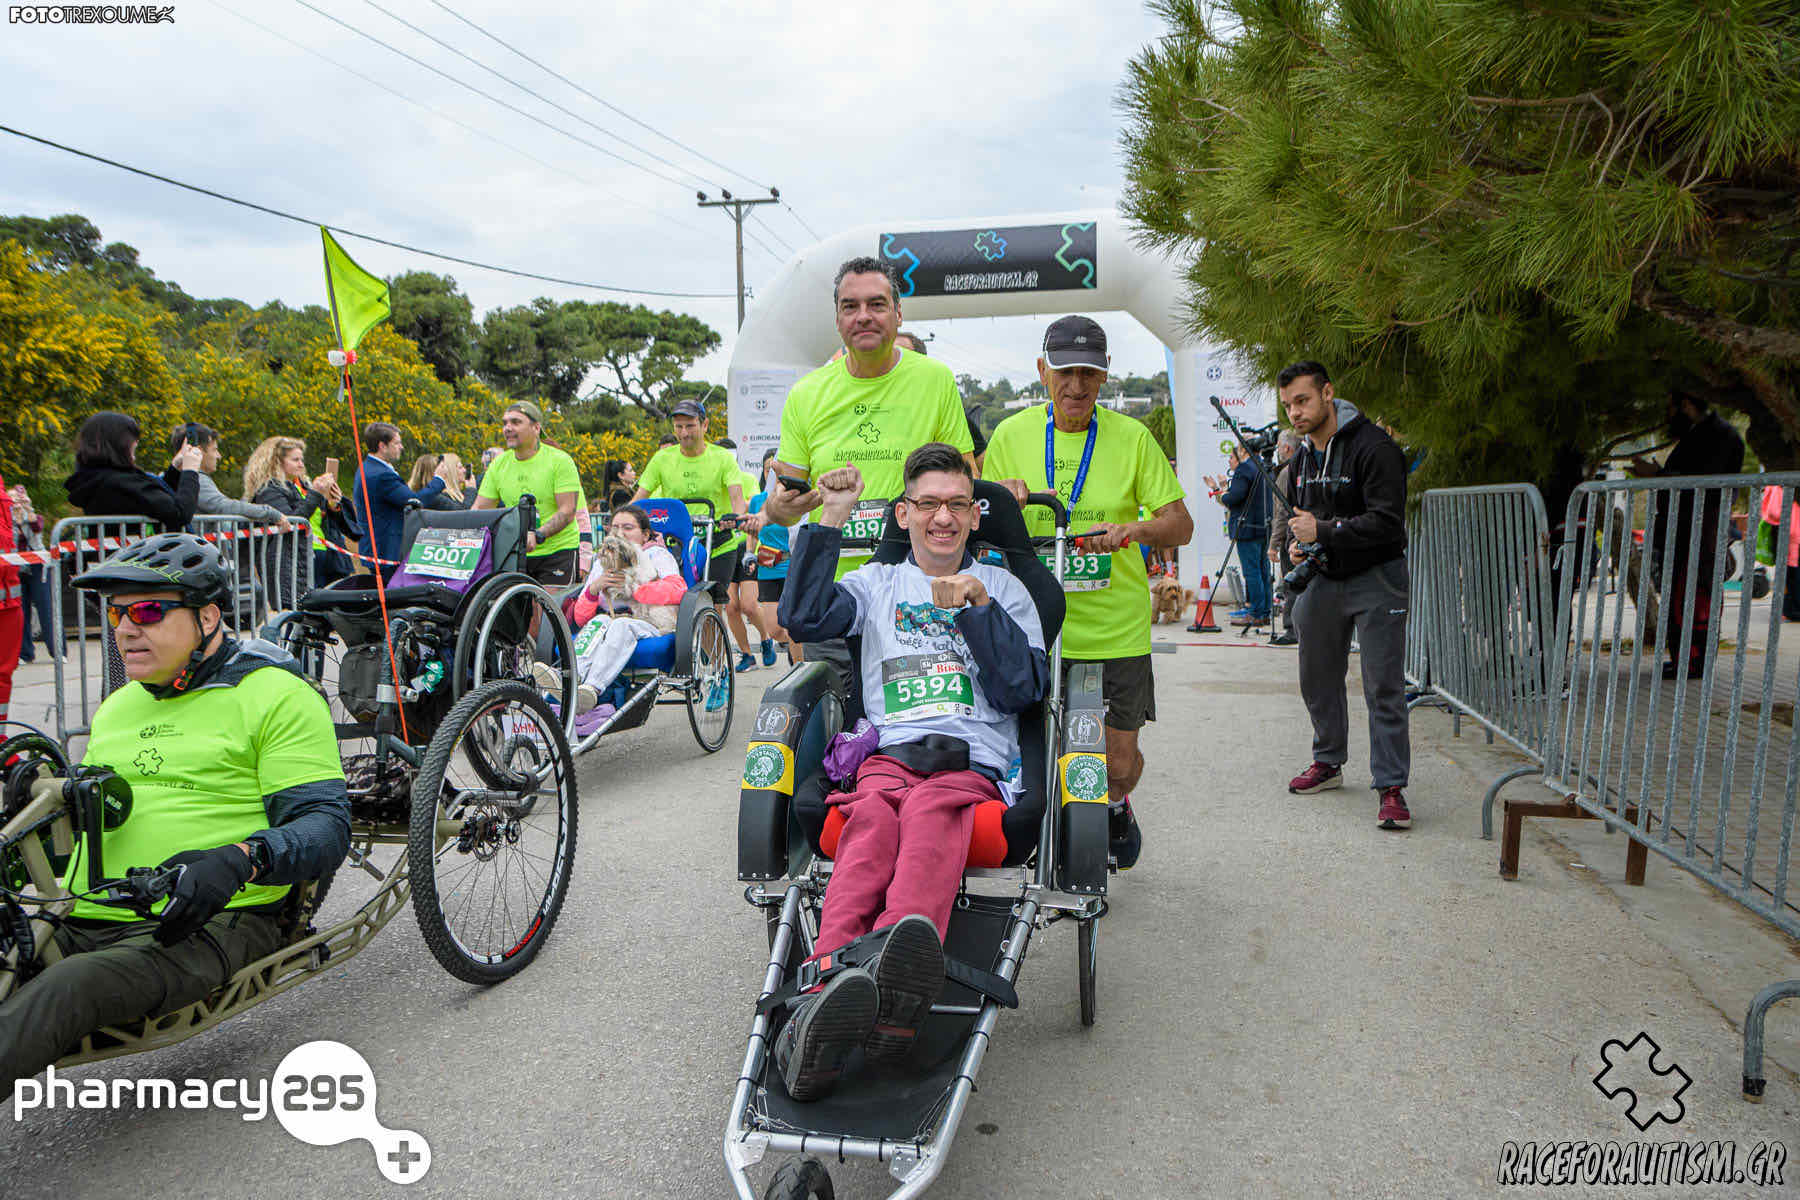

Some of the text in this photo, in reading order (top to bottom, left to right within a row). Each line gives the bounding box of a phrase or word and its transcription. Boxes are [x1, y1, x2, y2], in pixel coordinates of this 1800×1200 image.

[944, 270, 1039, 291] RACEFORAUTISM.GR
[841, 520, 880, 539] 389
[421, 545, 470, 565] 5007
[896, 674, 963, 703] 5394
